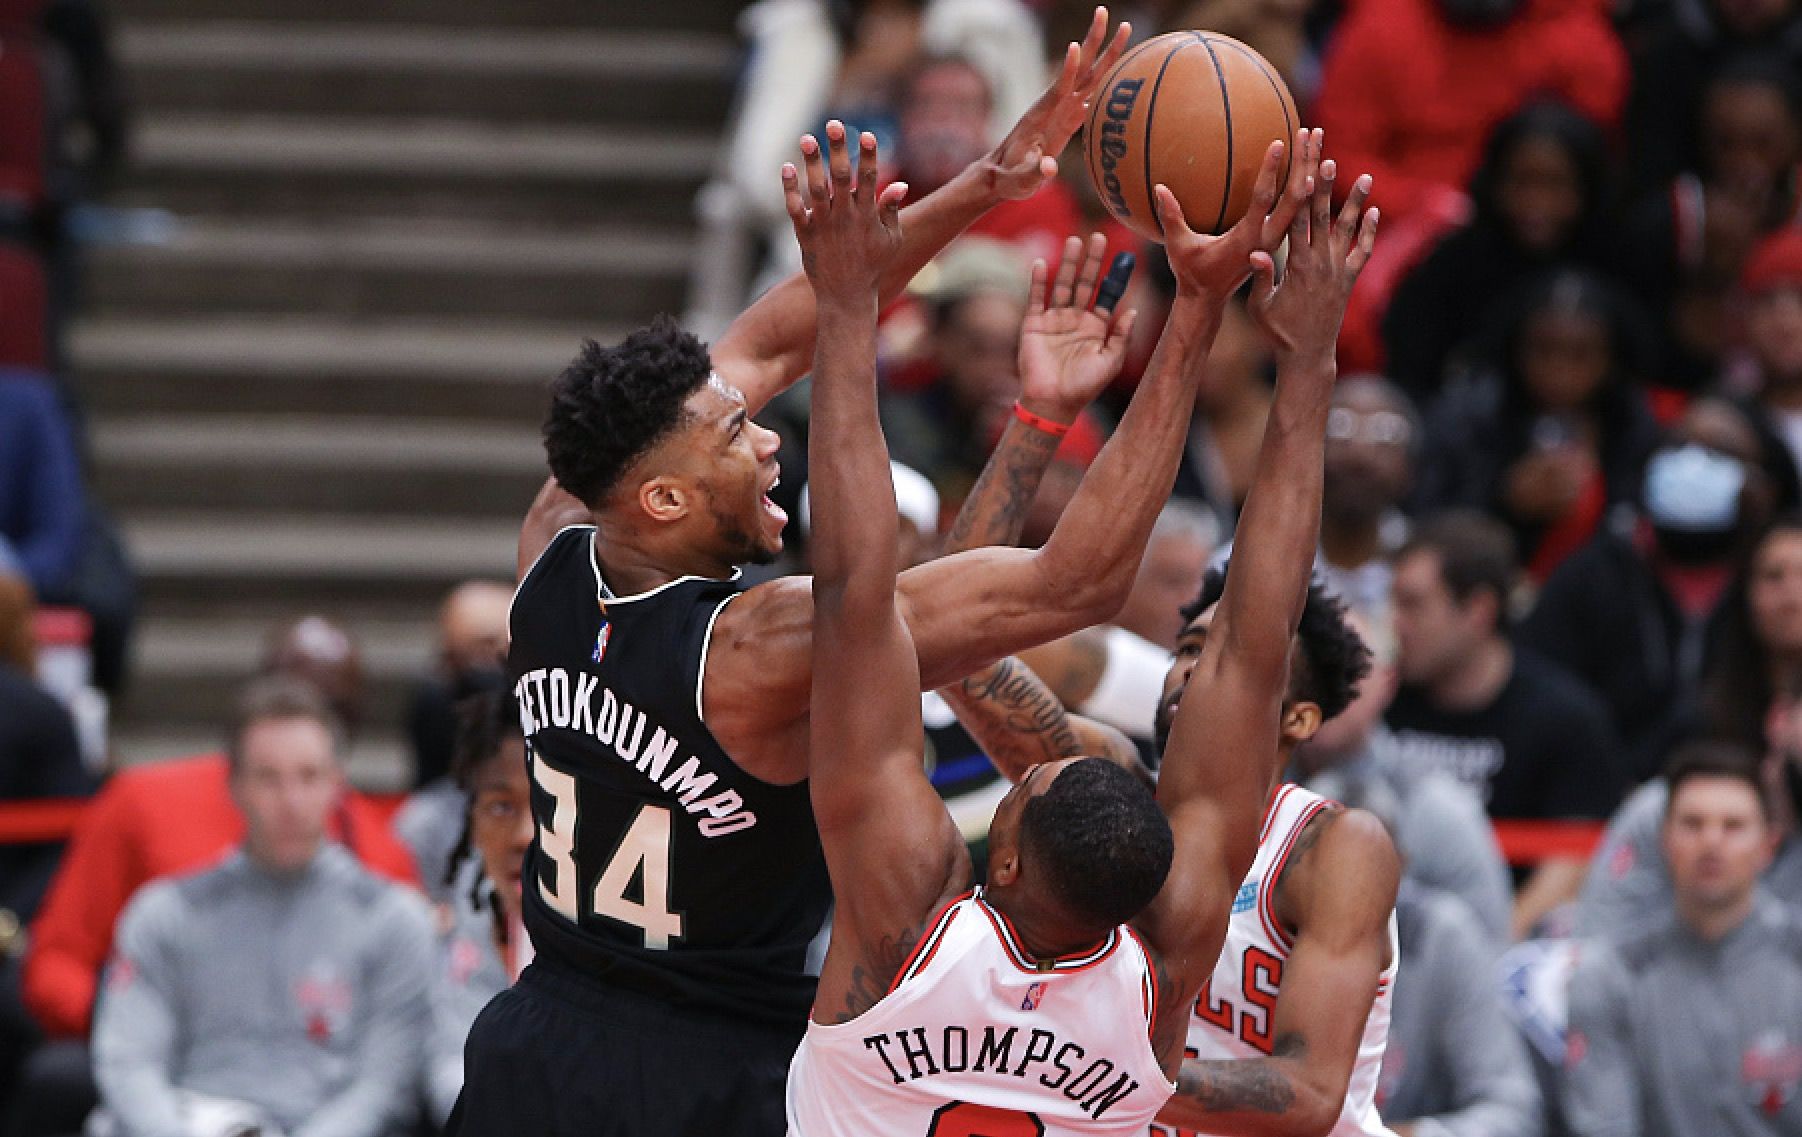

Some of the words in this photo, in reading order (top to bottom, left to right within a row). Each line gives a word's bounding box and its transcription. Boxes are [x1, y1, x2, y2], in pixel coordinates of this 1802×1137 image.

[1102, 77, 1146, 217] Wilson
[532, 751, 682, 950] 34
[863, 1025, 1139, 1120] THOMPSON
